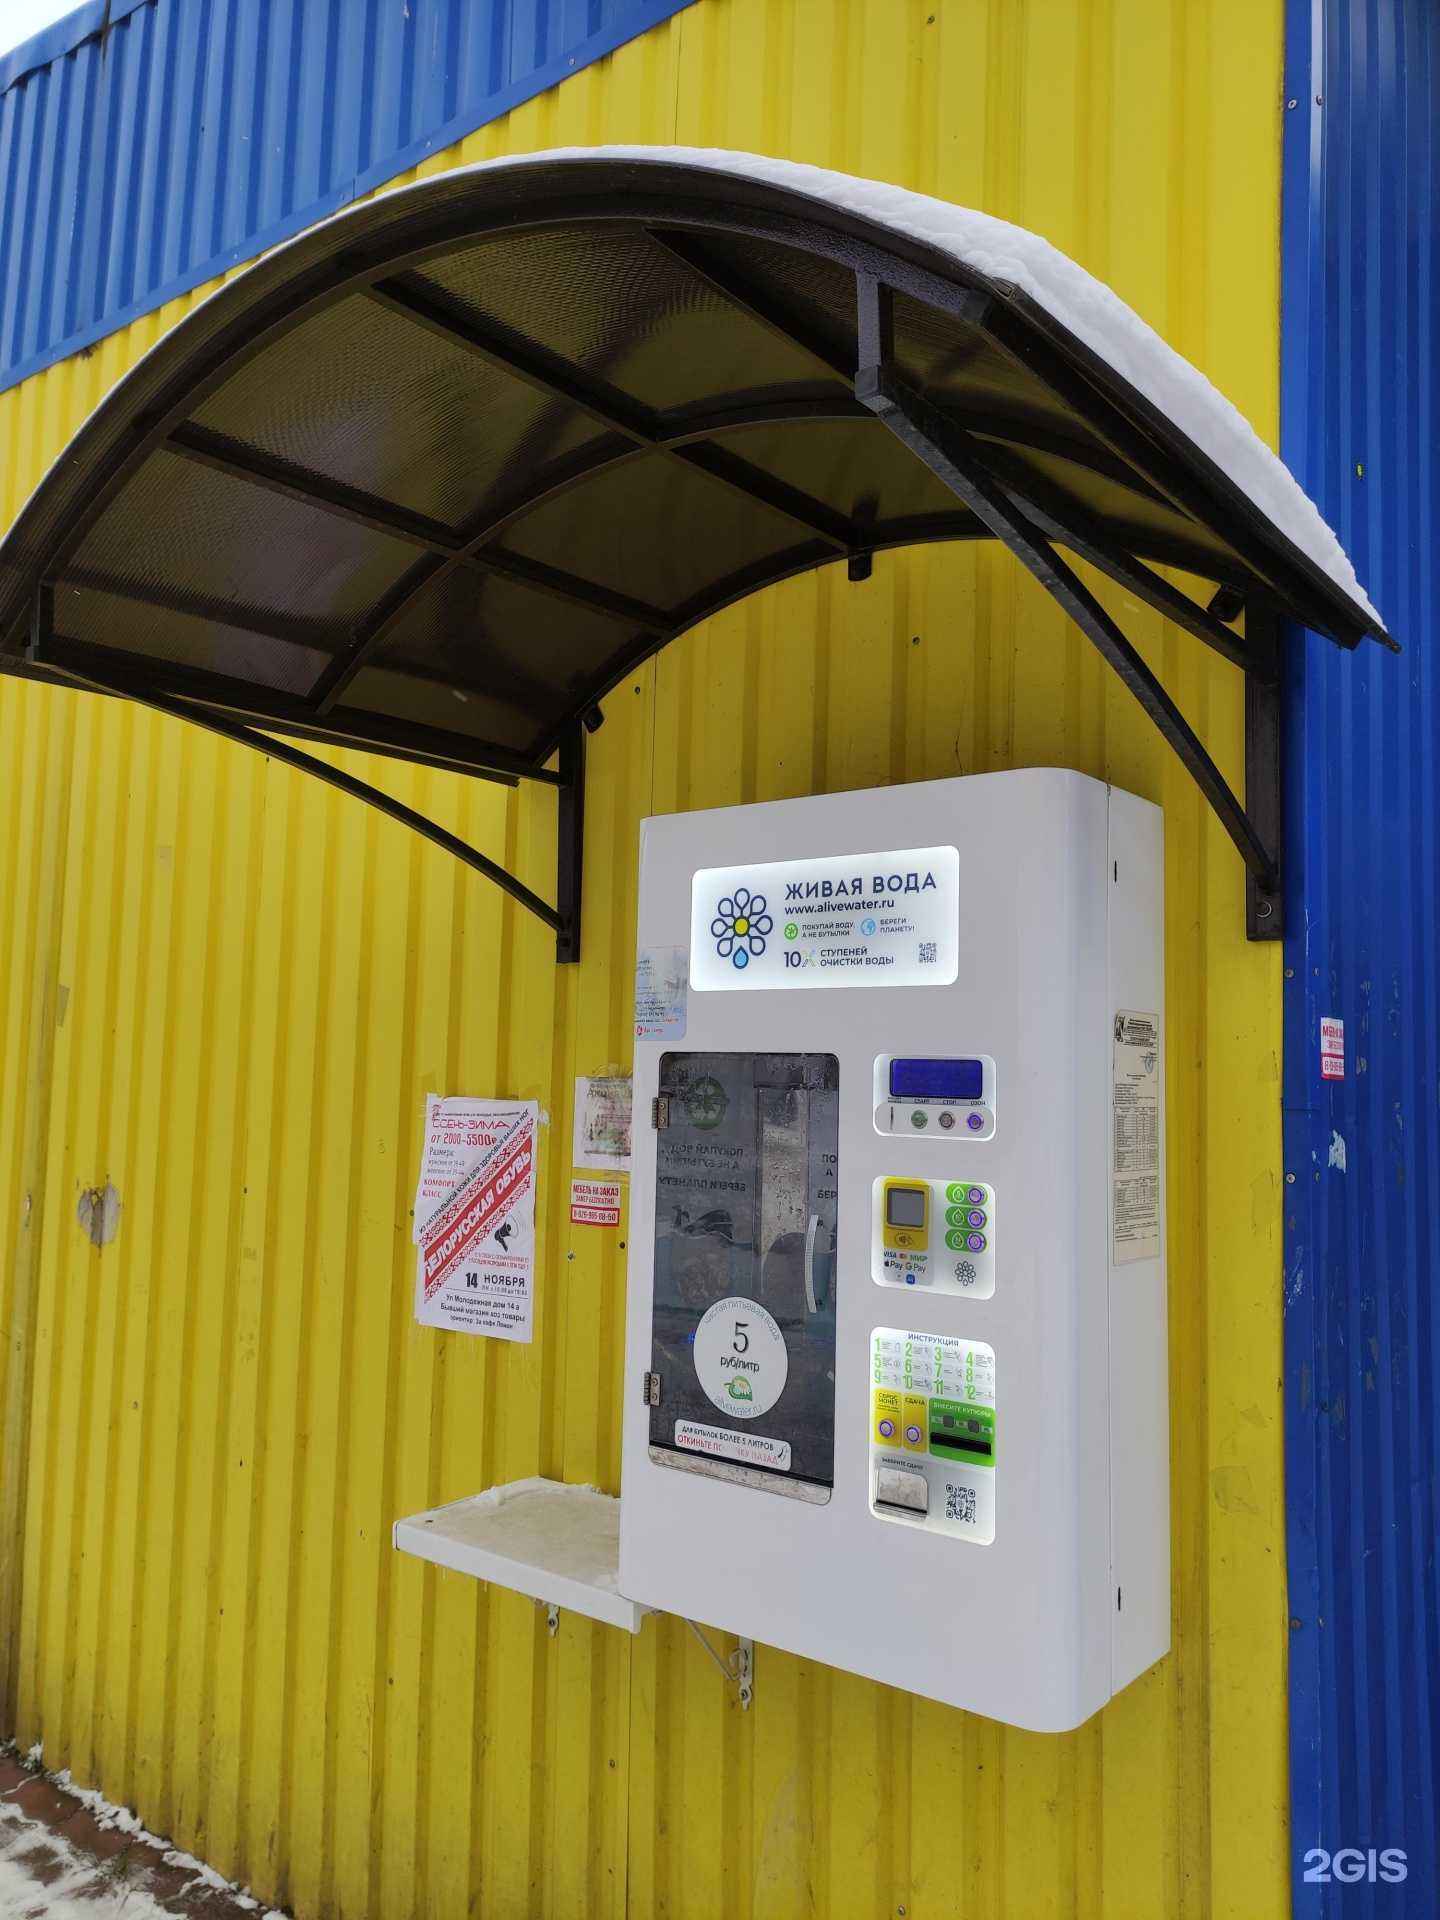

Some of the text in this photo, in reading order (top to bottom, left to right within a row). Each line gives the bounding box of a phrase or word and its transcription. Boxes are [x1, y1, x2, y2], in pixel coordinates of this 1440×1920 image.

[785, 871, 937, 900] ЖИВАЯ ВОДА
[784, 899, 895, 915] www.alivewater.ru
[802, 922, 834, 931] ПОКУПАЙ
[880, 918, 907, 926] БЕРЕГИ
[880, 925, 915, 934] ПЛАНЕТУ!
[818, 929, 850, 938] БУТЫЛКИ
[820, 946, 868, 957] СТУПЕНЕЙ
[784, 951, 802, 968] 10
[820, 956, 894, 967] ОЧИСТКИ ВОДЫ
[495, 1152, 531, 1194] ОБУВЬ
[600, 1187, 619, 1196] ЗАКАЗ
[425, 1192, 458, 1228] НАТУРАЛЬНОЙ
[456, 1177, 472, 1196] КОЖИ
[890, 1260, 903, 1270] Pay
[913, 1263, 926, 1273] Pay
[465, 1272, 525, 1288] 14 НОЯБРЯ
[733, 1321, 749, 1353] 5
[875, 1337, 881, 1352] 1
[907, 1333, 959, 1347] ИНСТРУКЦИЯ
[905, 1342, 913, 1357] 2
[935, 1346, 942, 1361] 3
[720, 1356, 760, 1373] руб/литр
[905, 1360, 912, 1373] 6
[966, 1352, 973, 1367] 4
[935, 1362, 942, 1378] 7
[966, 1367, 973, 1382] 8
[903, 1375, 912, 1390] 10
[934, 1379, 944, 1395] 11
[934, 1402, 961, 1412] ВНЕСИТЕ
[678, 1434, 713, 1451] ОТКИНЬТЕ
[682, 1425, 693, 1433] ДЛЯ
[693, 1429, 718, 1439] БУТЫЛОК
[719, 1432, 741, 1444] БОЛЕЕ
[747, 1439, 774, 1451] ЛИТРОВ
